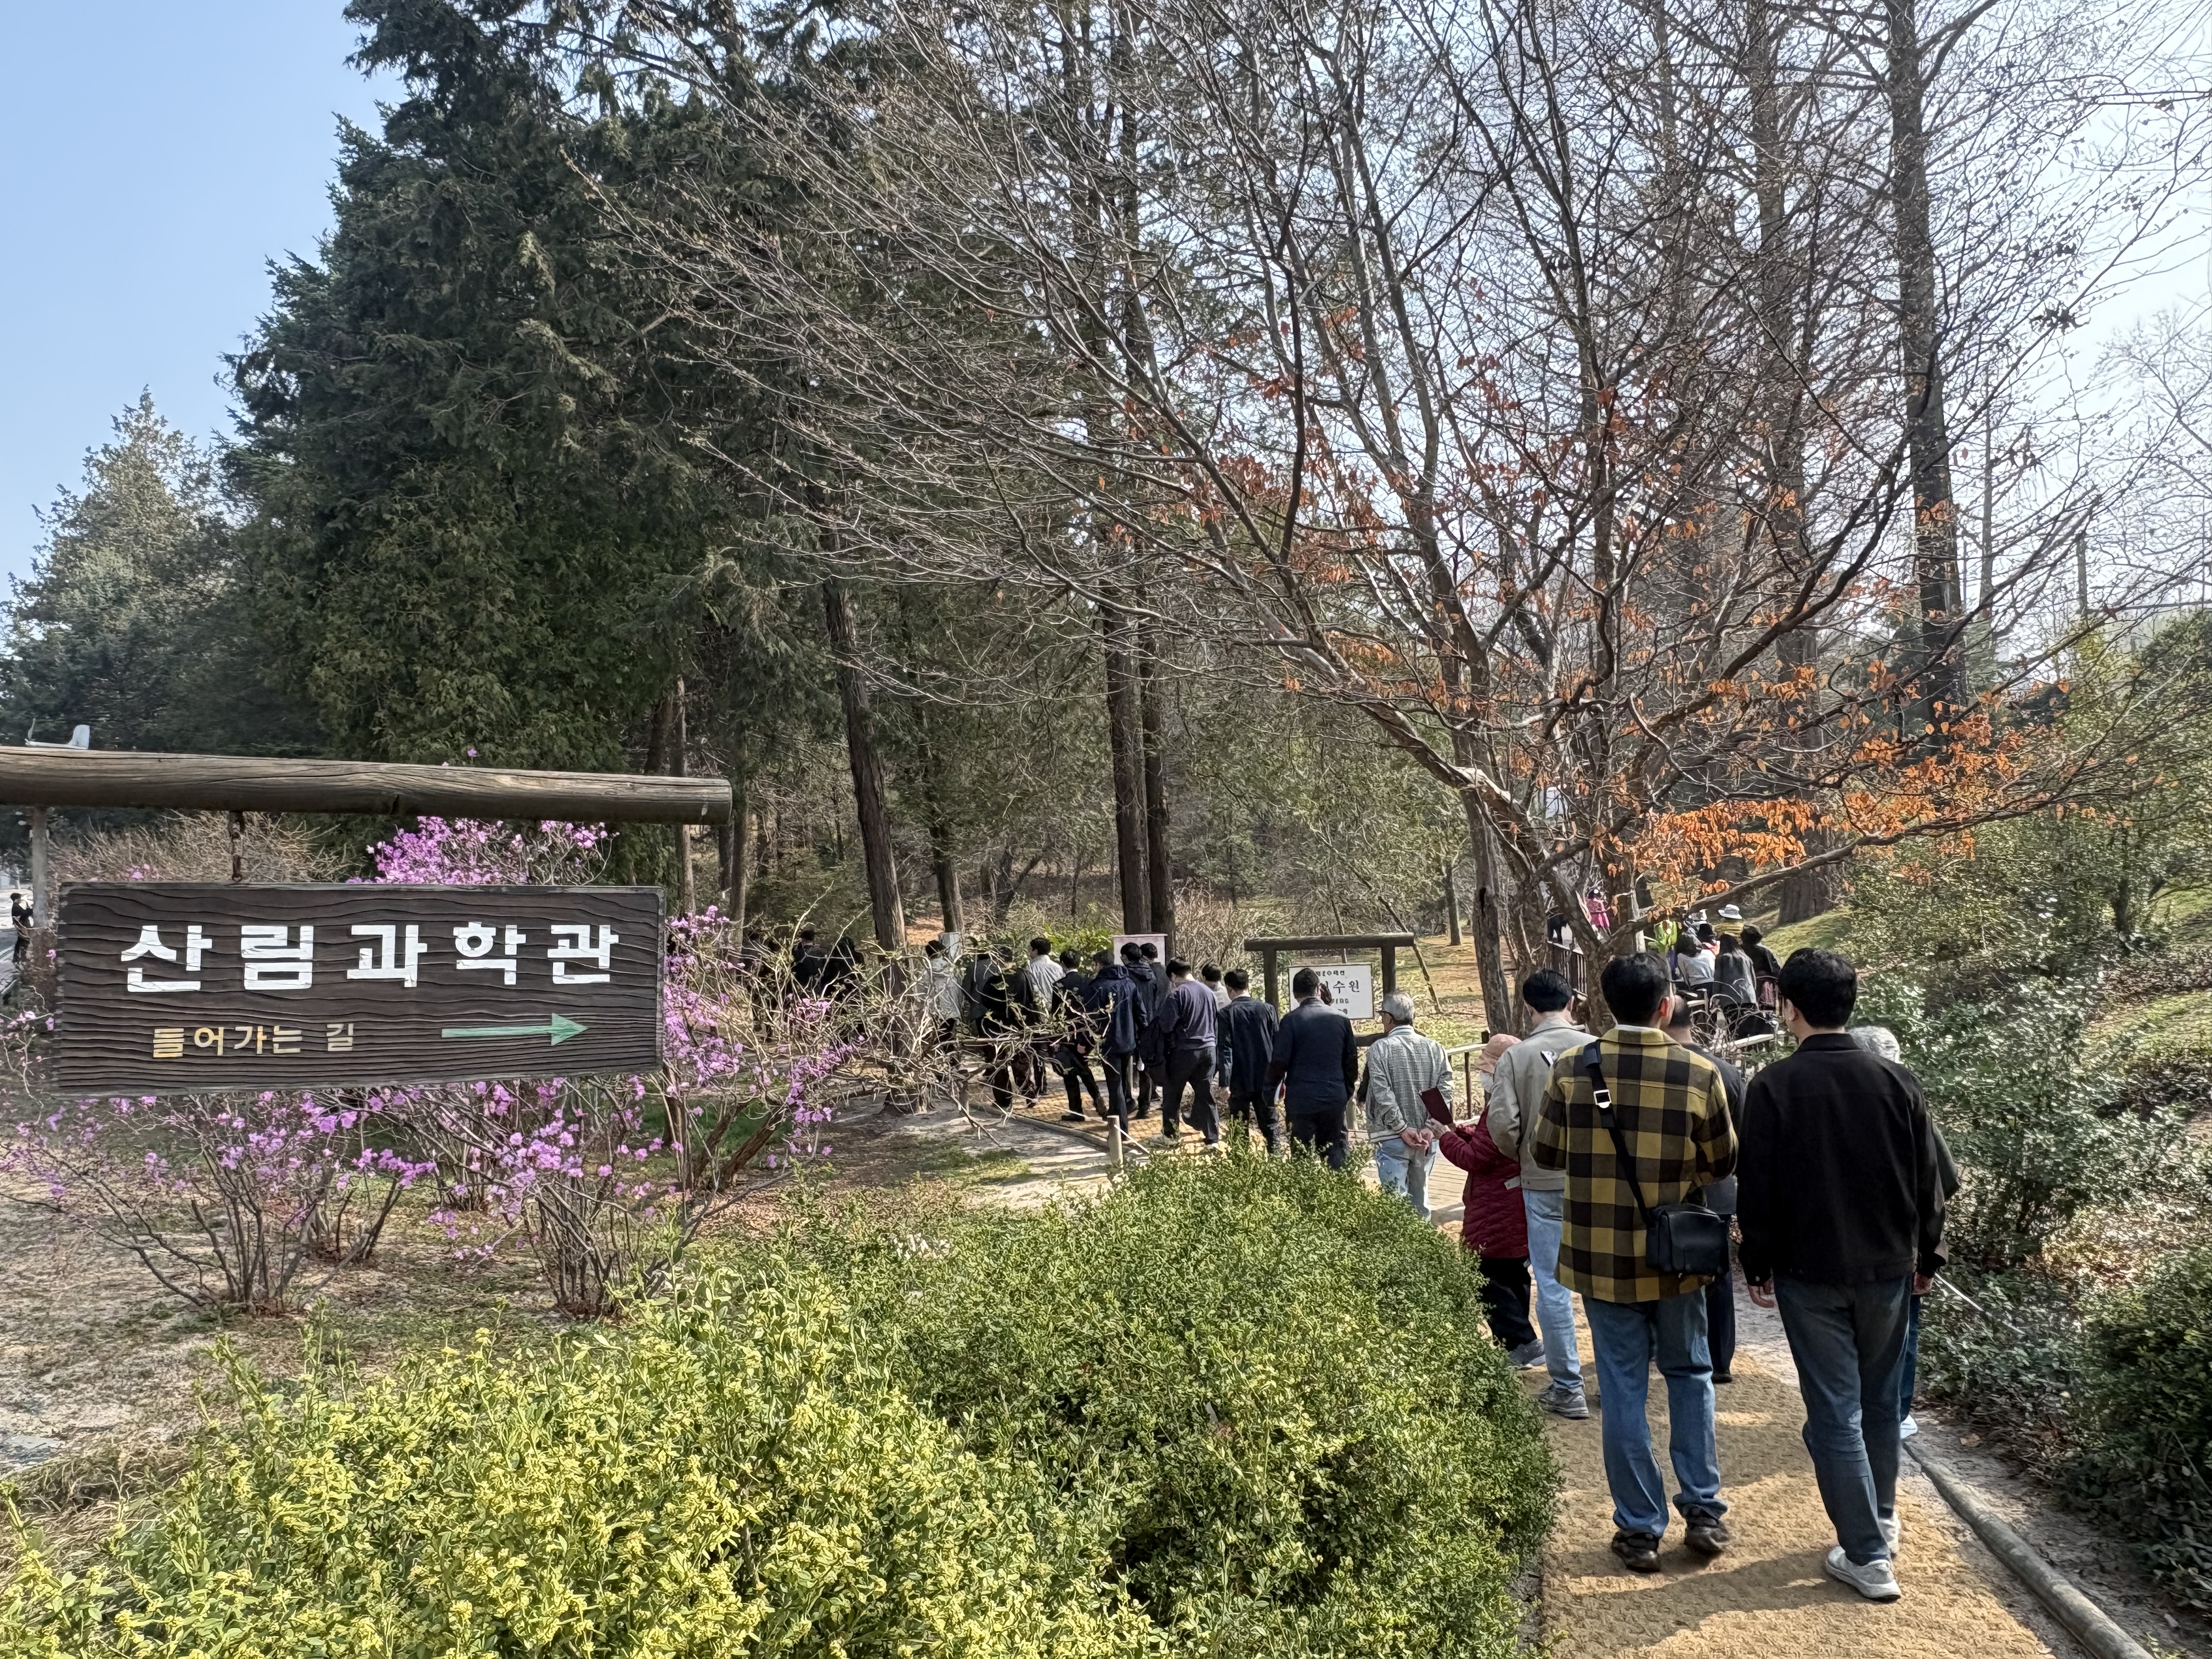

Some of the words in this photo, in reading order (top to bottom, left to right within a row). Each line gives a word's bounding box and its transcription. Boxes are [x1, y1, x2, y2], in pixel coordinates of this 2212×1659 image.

[121, 922, 619, 992] 산림과학관
[153, 1025, 303, 1058] 들어가는
[326, 1023, 354, 1052] 길
